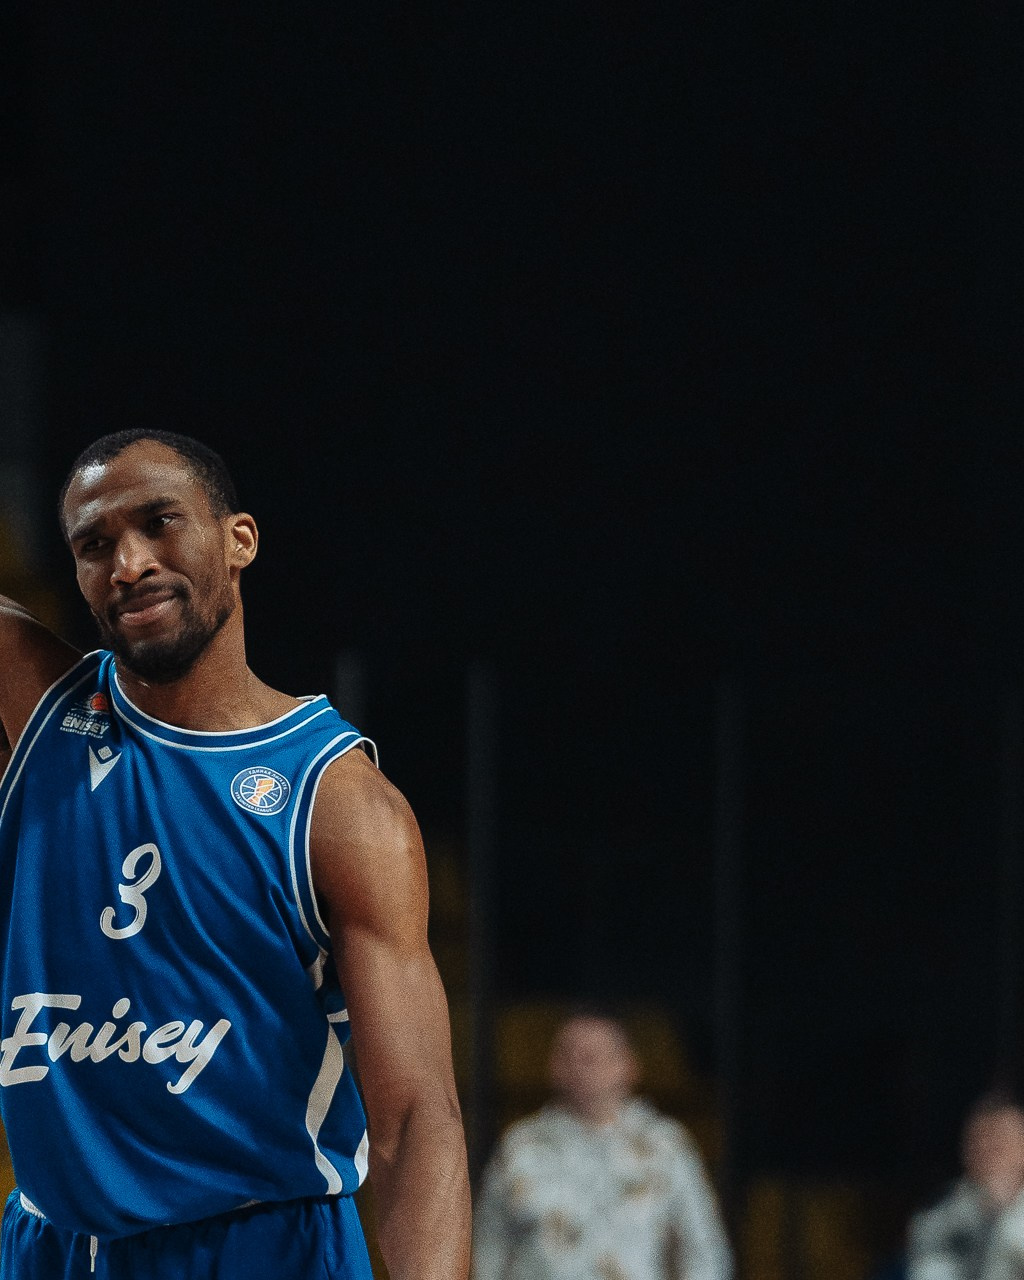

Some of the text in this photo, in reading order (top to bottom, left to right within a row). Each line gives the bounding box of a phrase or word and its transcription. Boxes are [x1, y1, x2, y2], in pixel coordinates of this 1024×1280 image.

[62, 715, 110, 735] ENISEY
[99, 842, 162, 941] 3
[0, 992, 232, 1095] Enisey
